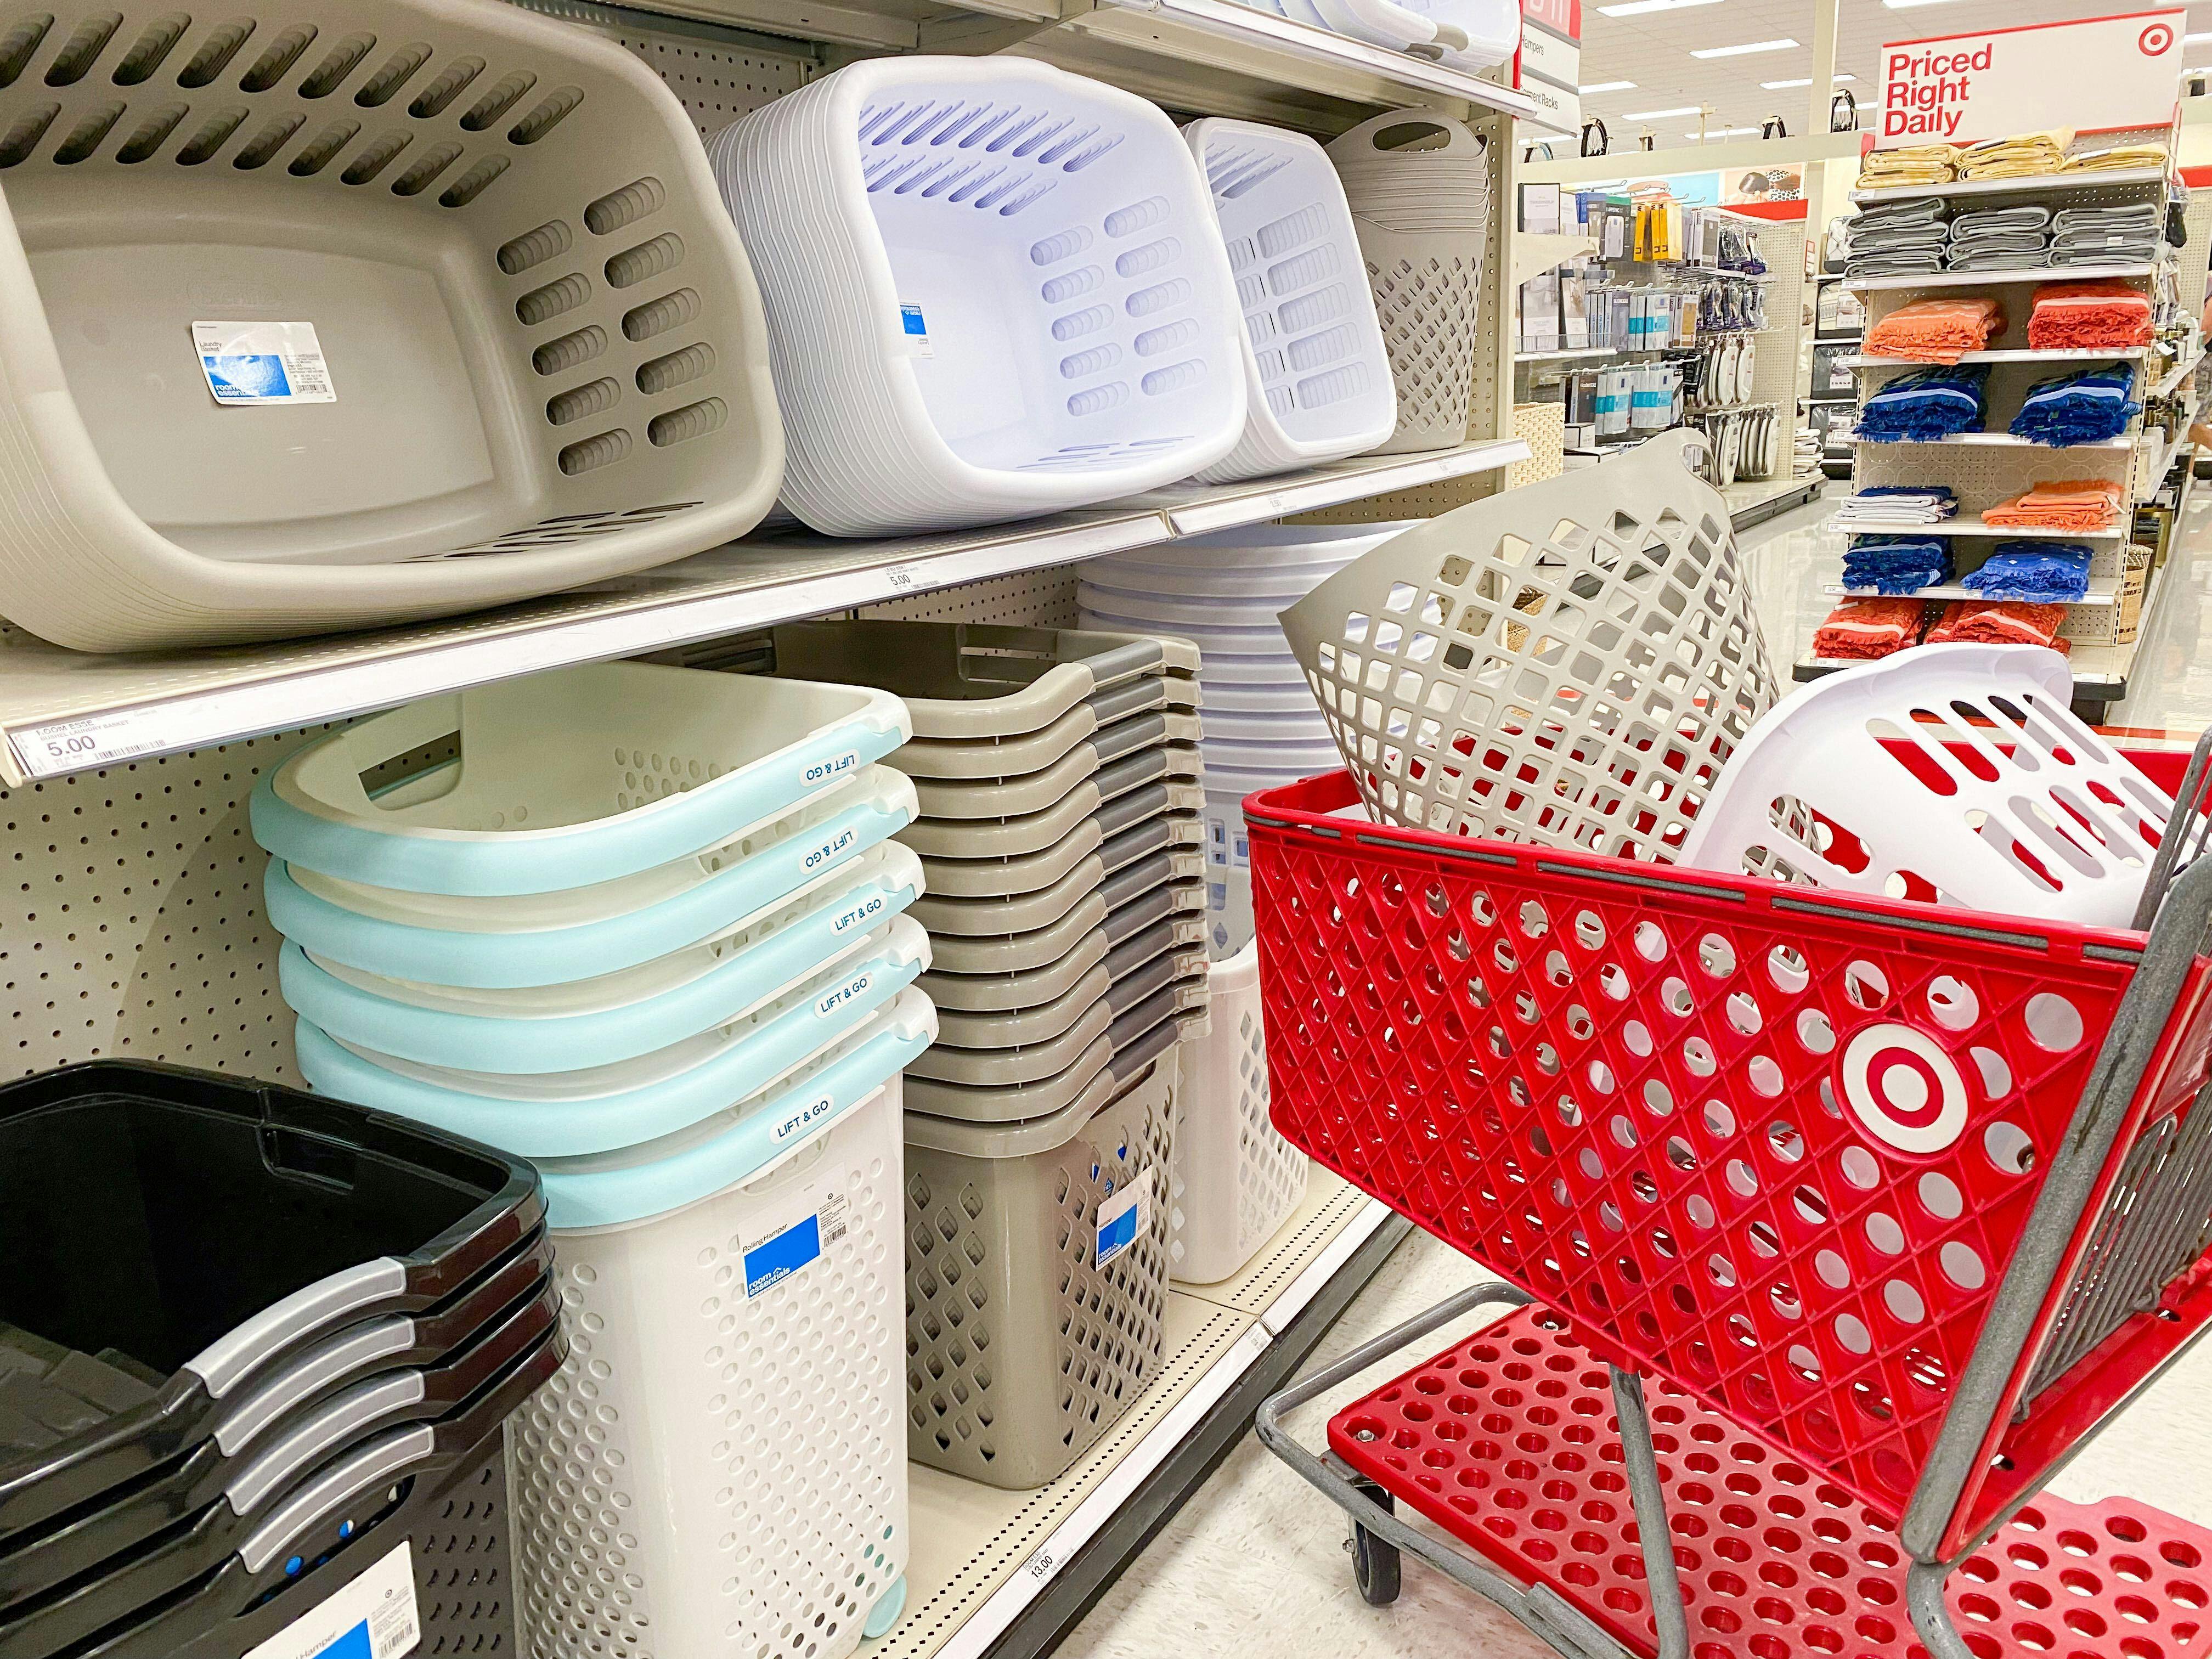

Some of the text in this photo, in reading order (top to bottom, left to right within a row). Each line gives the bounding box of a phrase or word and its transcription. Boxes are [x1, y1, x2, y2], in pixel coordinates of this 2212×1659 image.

[1522, 35, 1544, 56] Hampers
[1889, 43, 1993, 81] Priced
[1520, 84, 1558, 110] ment Racks
[1886, 76, 1970, 111] Right
[1884, 106, 1963, 137] Daily
[890, 574, 910, 585] 5.00
[41, 719, 129, 741] BUSHEL LAUNDRY BASKET
[69, 720, 94, 730] ESSE
[47, 735, 95, 756] 5.00
[806, 754, 855, 780] LIFT & GO
[806, 831, 853, 867] LIFT & GO
[835, 899, 881, 930] LIFT & GO
[820, 978, 867, 1013] LIFT & GO
[778, 1100, 828, 1137] LIFT & GO
[743, 1223, 788, 1253] Rolling Hamper
[1099, 1246, 1112, 1259] room
[748, 1272, 771, 1290] room
[749, 1267, 791, 1296] essentials
[1031, 1555, 1053, 1578] 13.00
[300, 1630, 336, 1659] Hamper
